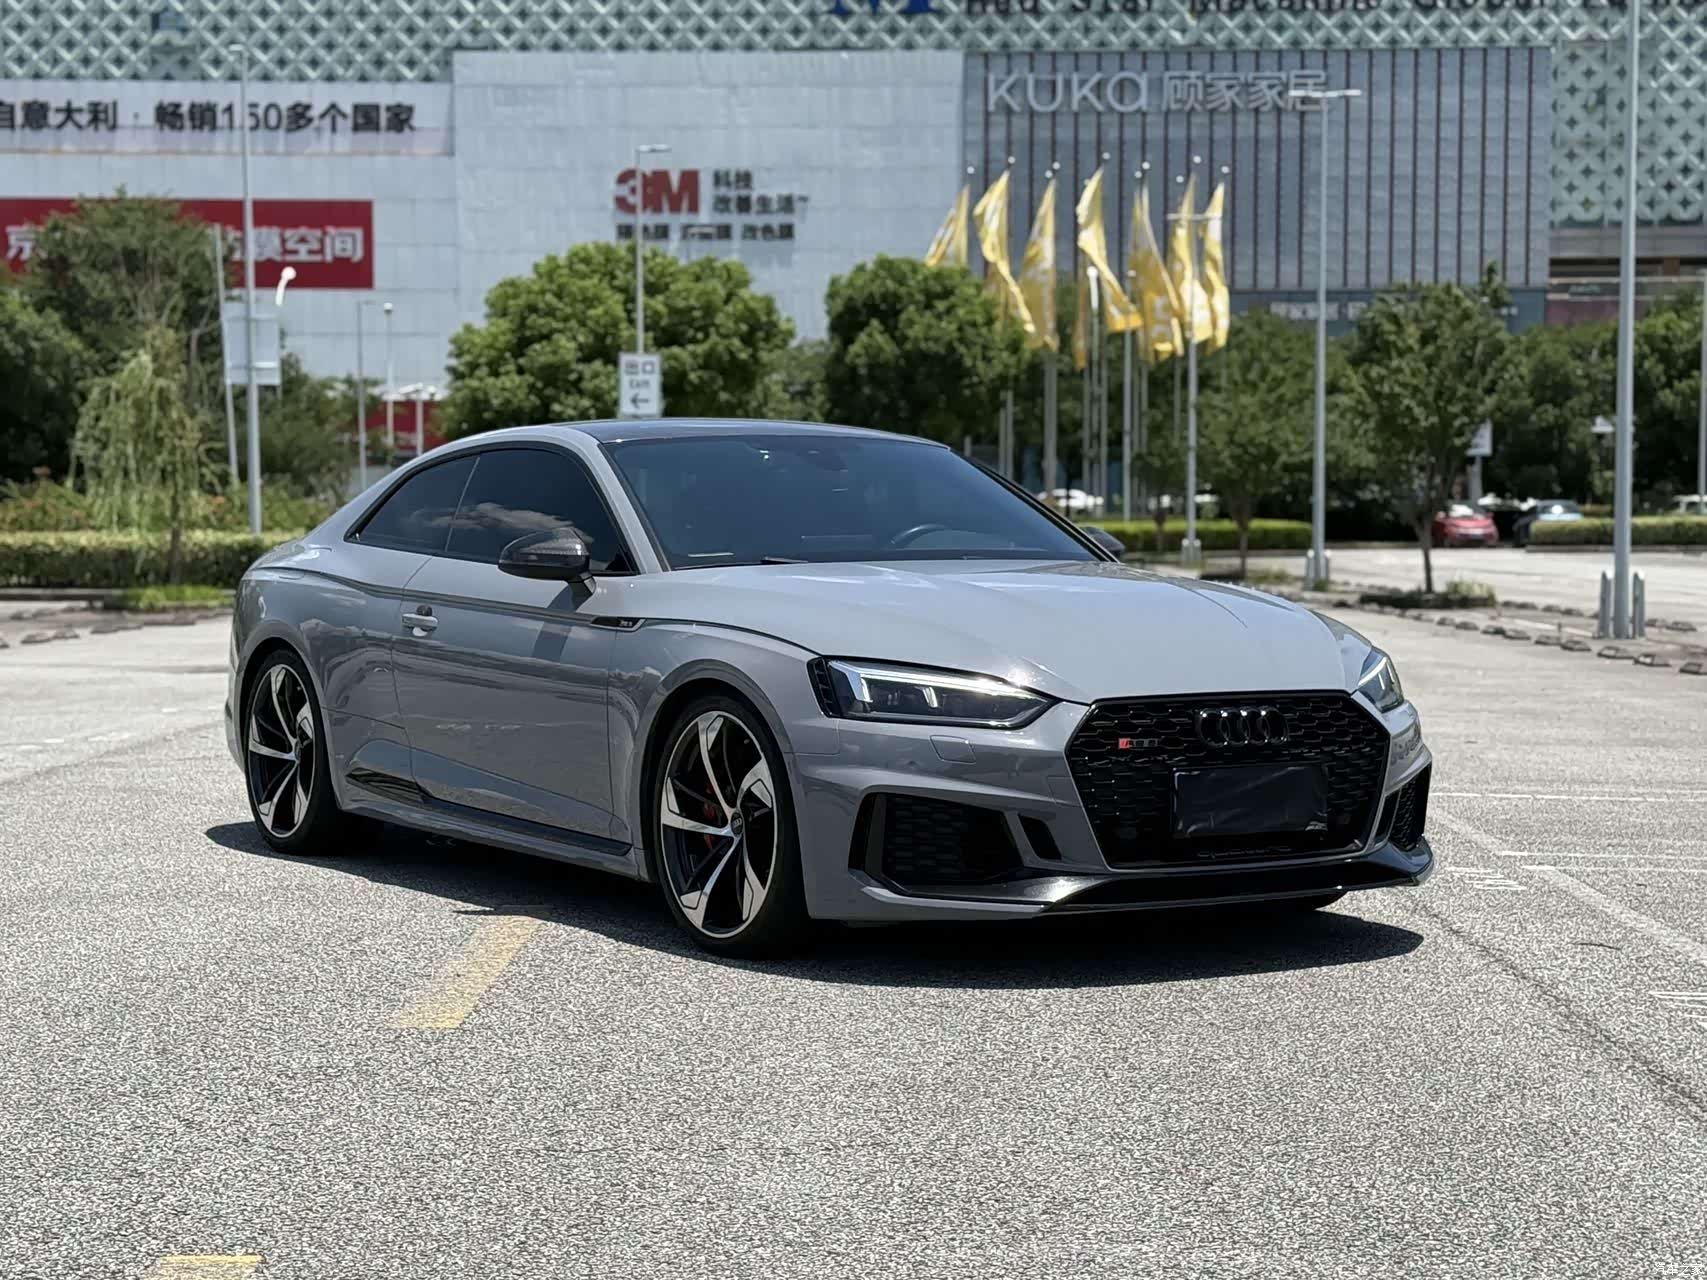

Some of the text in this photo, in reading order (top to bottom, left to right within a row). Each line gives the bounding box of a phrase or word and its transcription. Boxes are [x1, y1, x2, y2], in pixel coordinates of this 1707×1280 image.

[1162, 70, 1327, 112] 顾家家居
[155, 101, 416, 133] 畅销150多个国家
[613, 168, 700, 215] 3M
